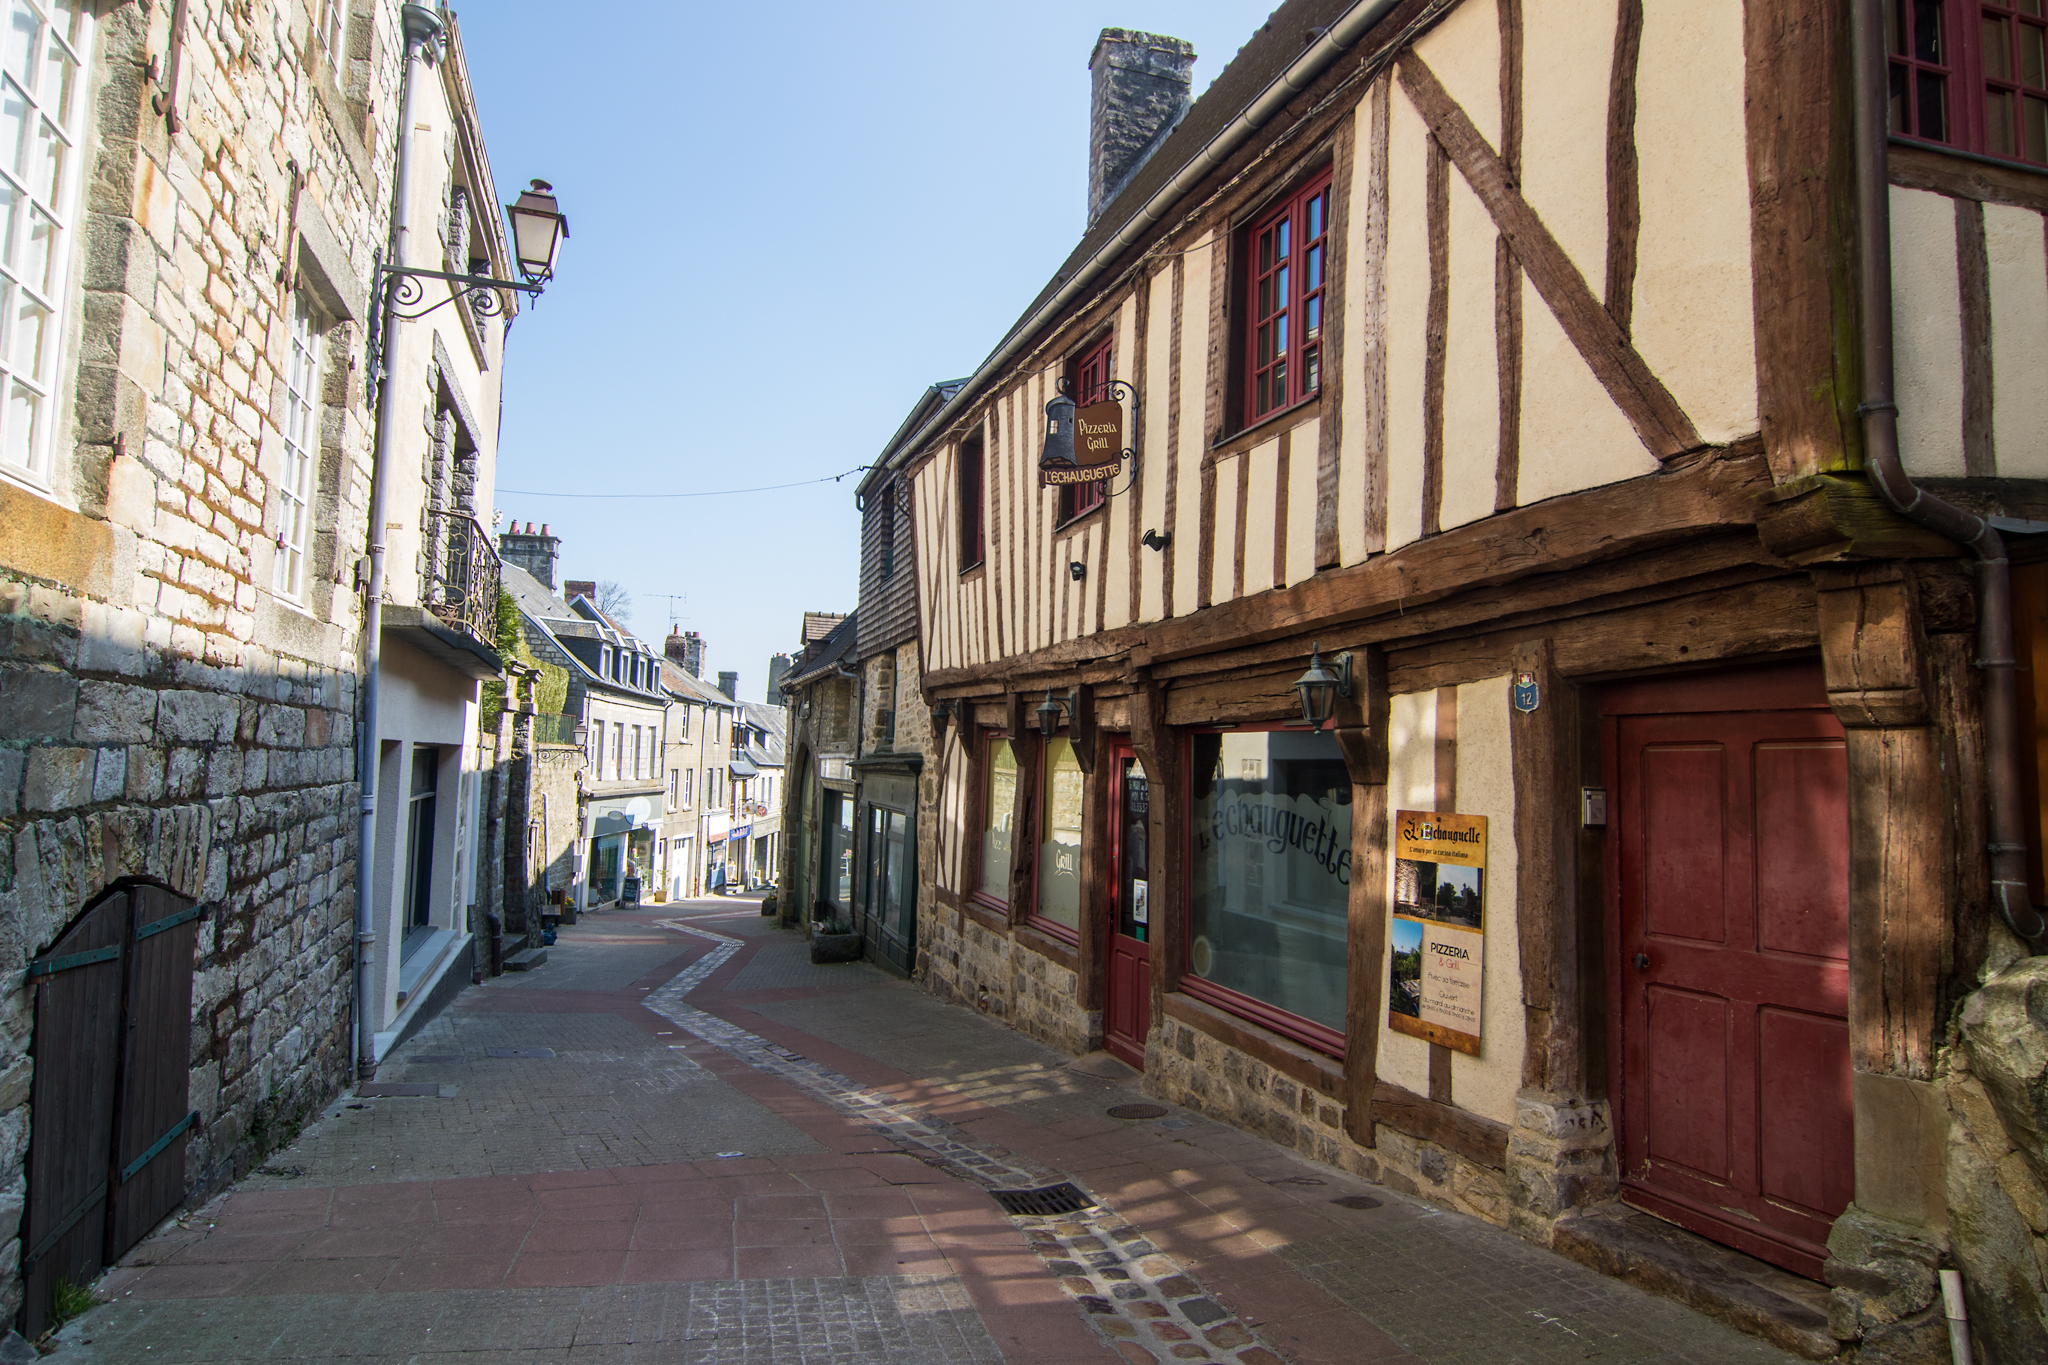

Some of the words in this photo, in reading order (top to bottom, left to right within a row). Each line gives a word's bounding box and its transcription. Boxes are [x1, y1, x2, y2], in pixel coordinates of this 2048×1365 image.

[1078, 418, 1117, 436] Pizzeria
[1086, 437, 1109, 453] Grill
[1044, 463, 1120, 484] L'ECHAUGUETTE
[1521, 692, 1533, 705] 12
[1055, 849, 1073, 872] Grill
[1430, 942, 1470, 960] PIZZERIA
[1446, 958, 1460, 970] Grill
